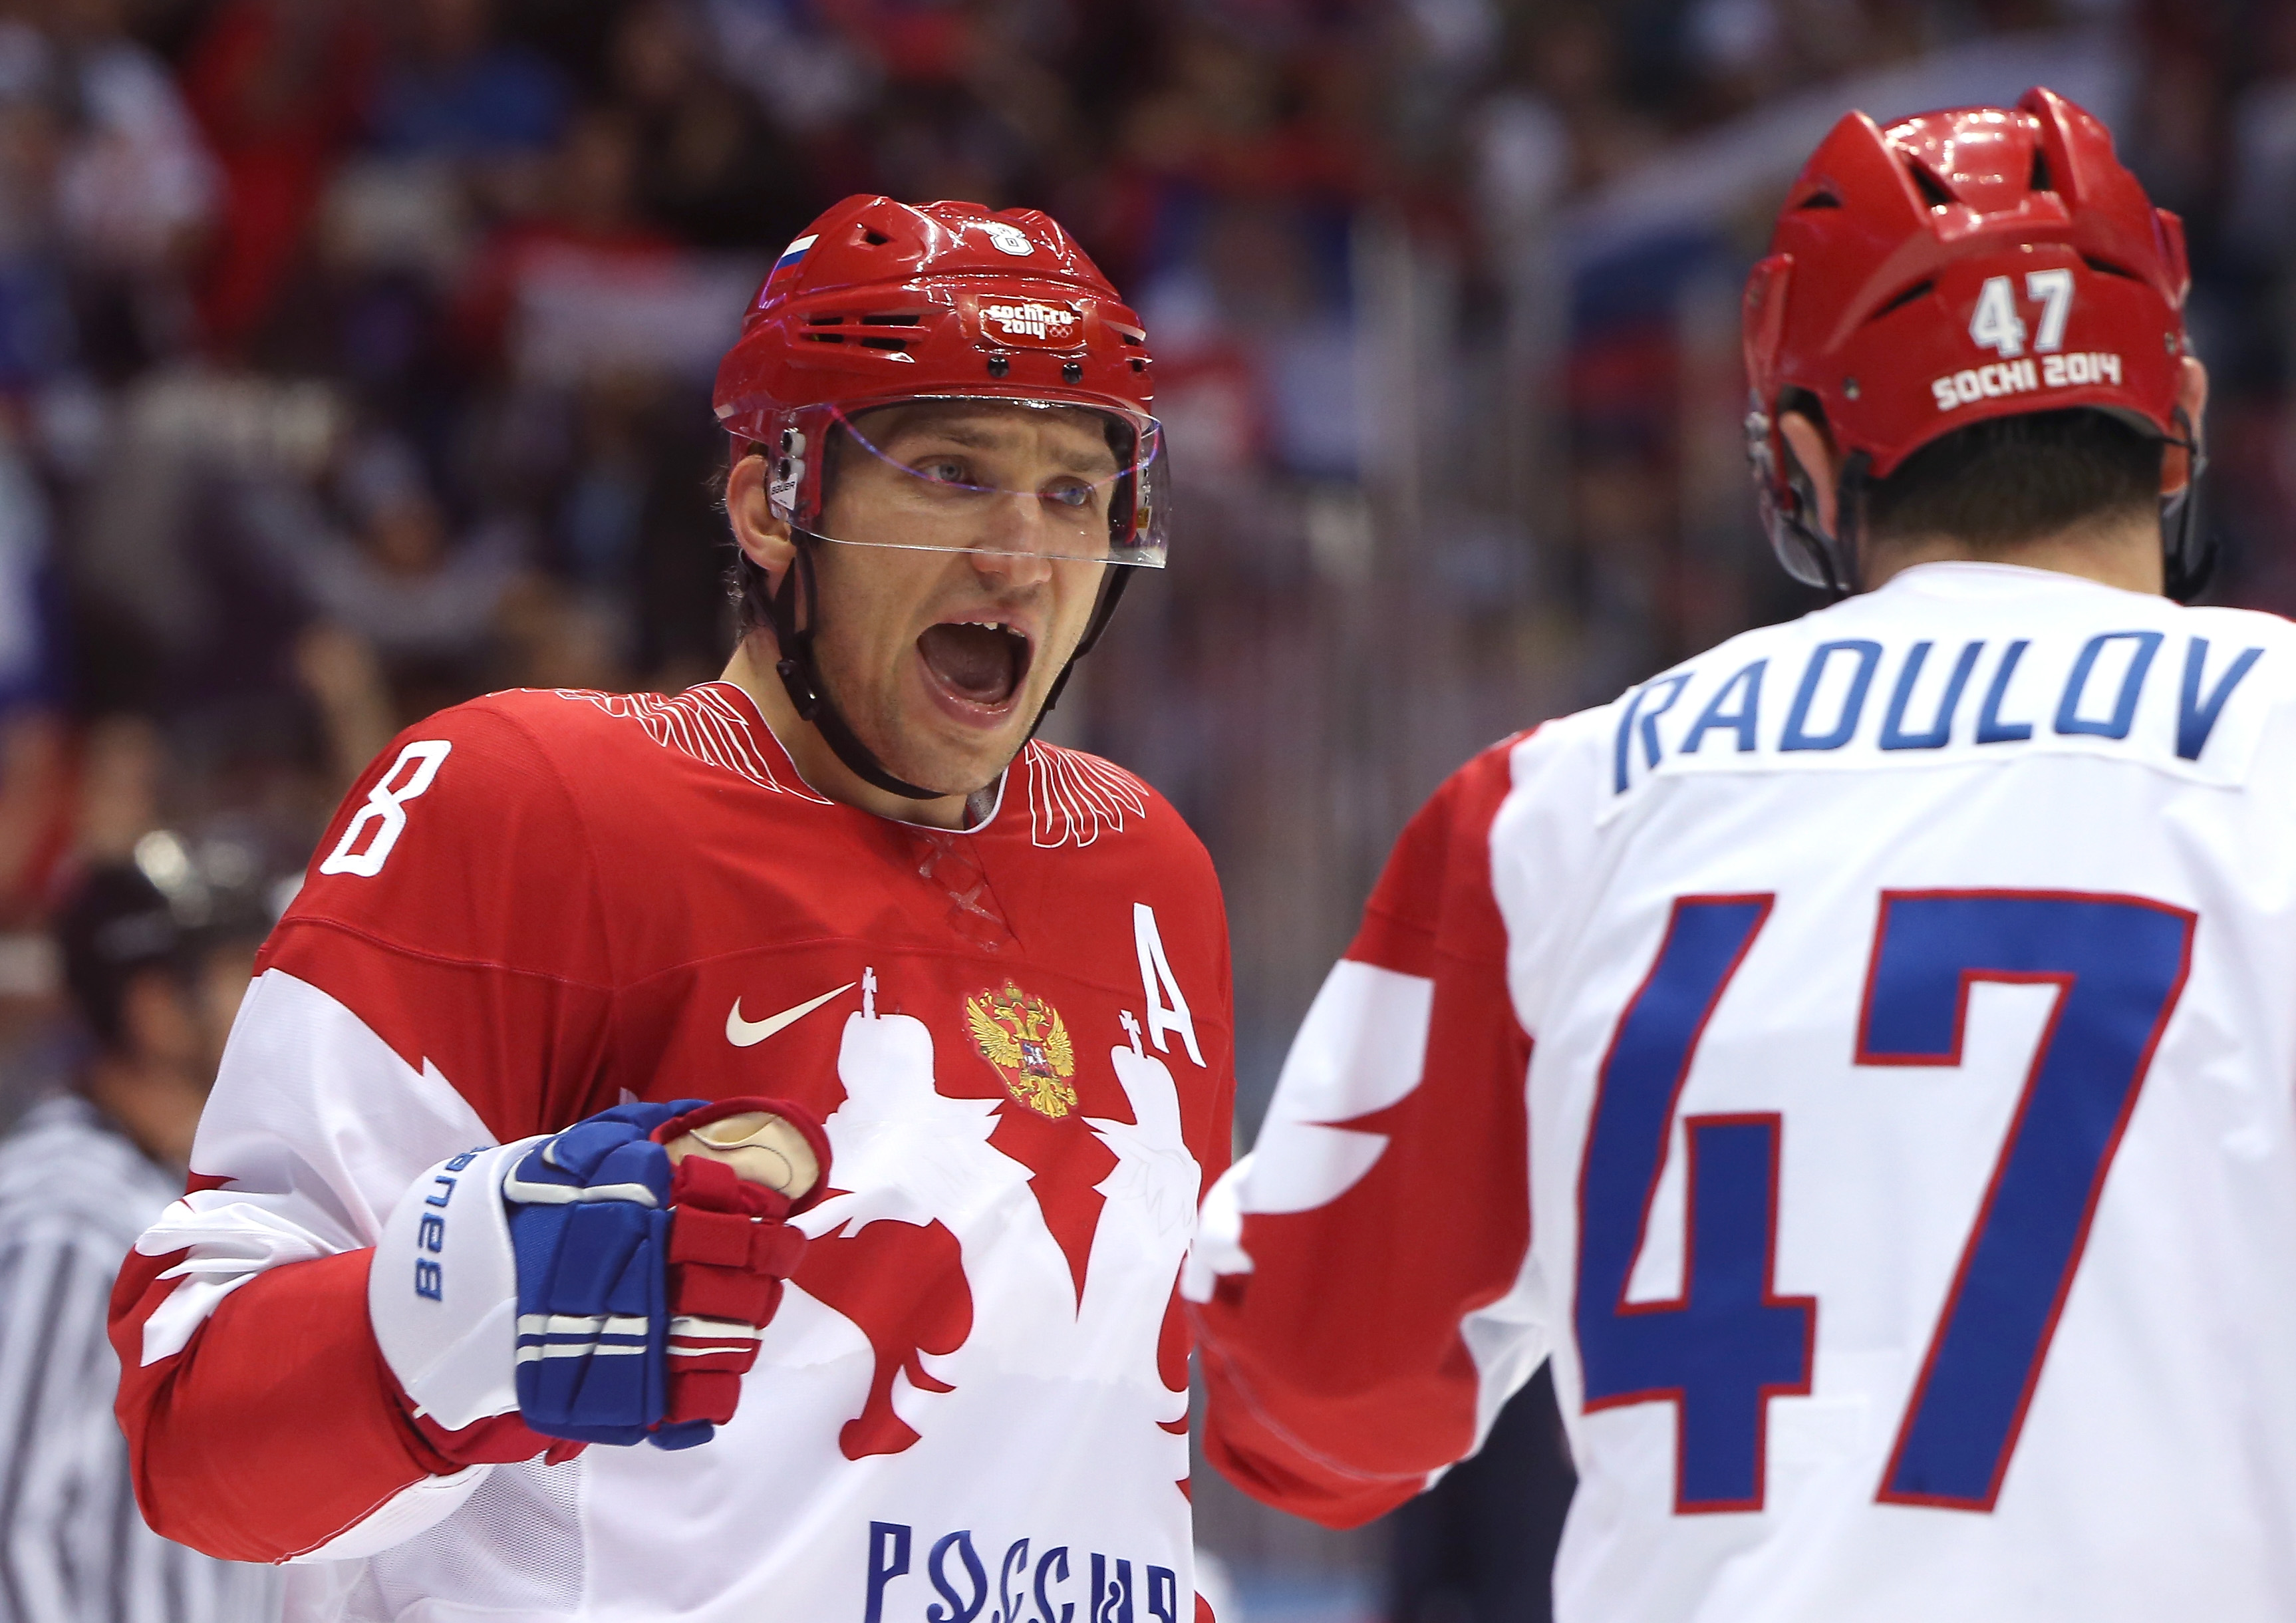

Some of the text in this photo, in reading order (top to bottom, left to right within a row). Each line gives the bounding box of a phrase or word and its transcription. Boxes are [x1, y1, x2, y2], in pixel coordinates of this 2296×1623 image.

[989, 222, 1035, 257] 8
[1001, 319, 1046, 340] 2014
[1967, 268, 2075, 357] 47
[1932, 353, 2122, 411] SOCHI 2014
[1614, 631, 2265, 796] RADULOV
[319, 739, 453, 877] 8
[1133, 902, 1207, 1068] A
[1572, 888, 2199, 1515] 47
